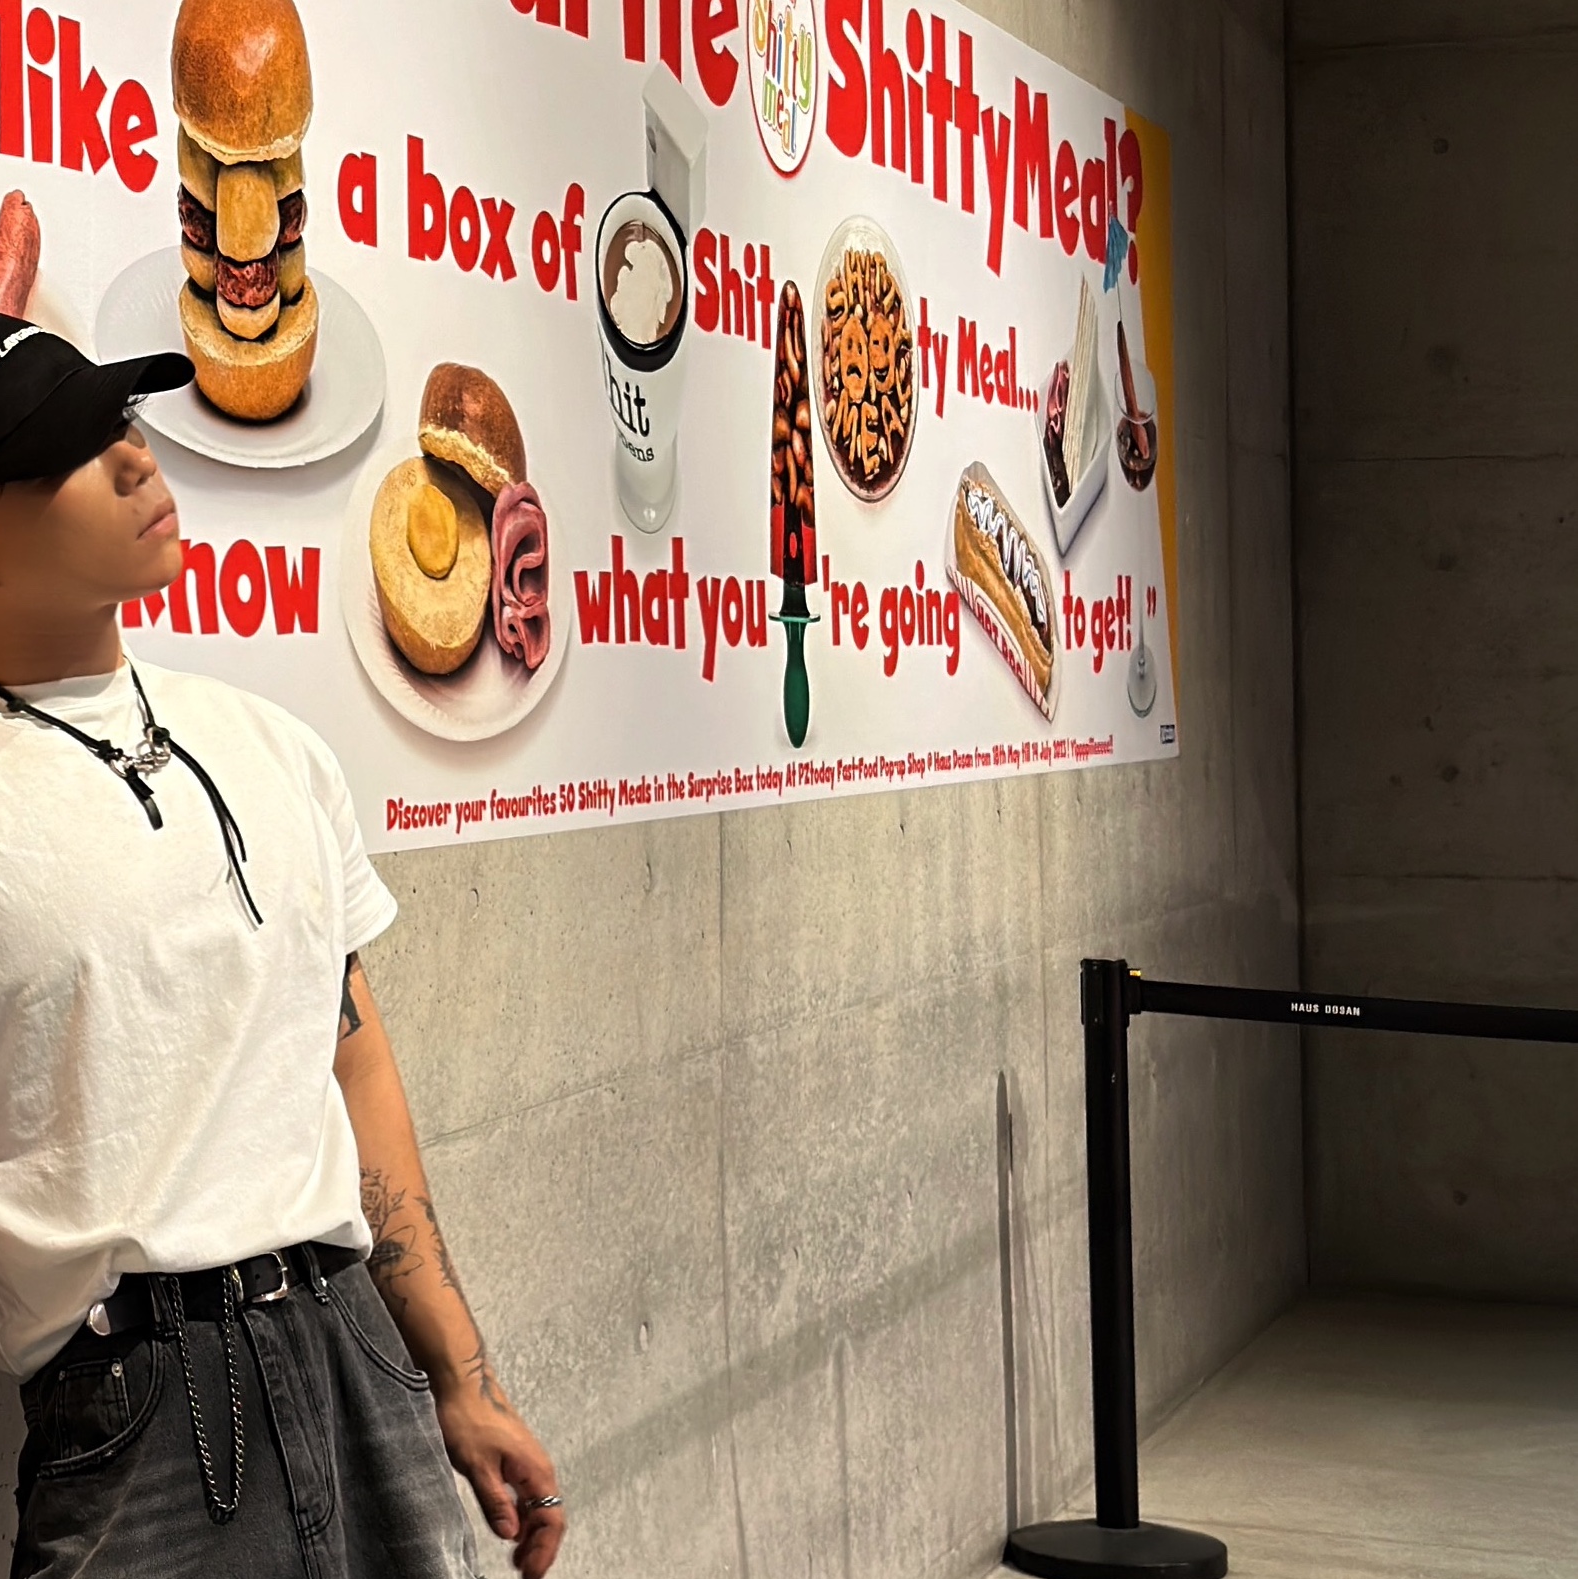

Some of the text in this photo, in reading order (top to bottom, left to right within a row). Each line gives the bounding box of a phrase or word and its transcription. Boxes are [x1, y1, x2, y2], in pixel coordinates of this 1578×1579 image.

[337, 152, 378, 248] a
[407, 135, 517, 282] box
[532, 183, 585, 301] of
[693, 227, 775, 350] Shit
[574, 535, 690, 651] what
[696, 576, 768, 683] you
[880, 560, 962, 677] going
[1063, 570, 1087, 651] to
[1090, 573, 1133, 675] get!
[386, 797, 452, 832] Discover
[455, 799, 486, 834] your
[490, 785, 557, 822] favourites
[559, 782, 575, 814] 50
[578, 779, 616, 817] Shitty
[618, 775, 652, 806] Meals
[654, 774, 665, 802] in
[667, 772, 684, 801] the
[687, 769, 733, 805] Surprise
[734, 766, 754, 795] Box
[755, 764, 783, 797] today
[785, 761, 796, 788] At
[907, 752, 925, 779] Shop
[1290, 1002, 1361, 1016] HAUS DOSAN
